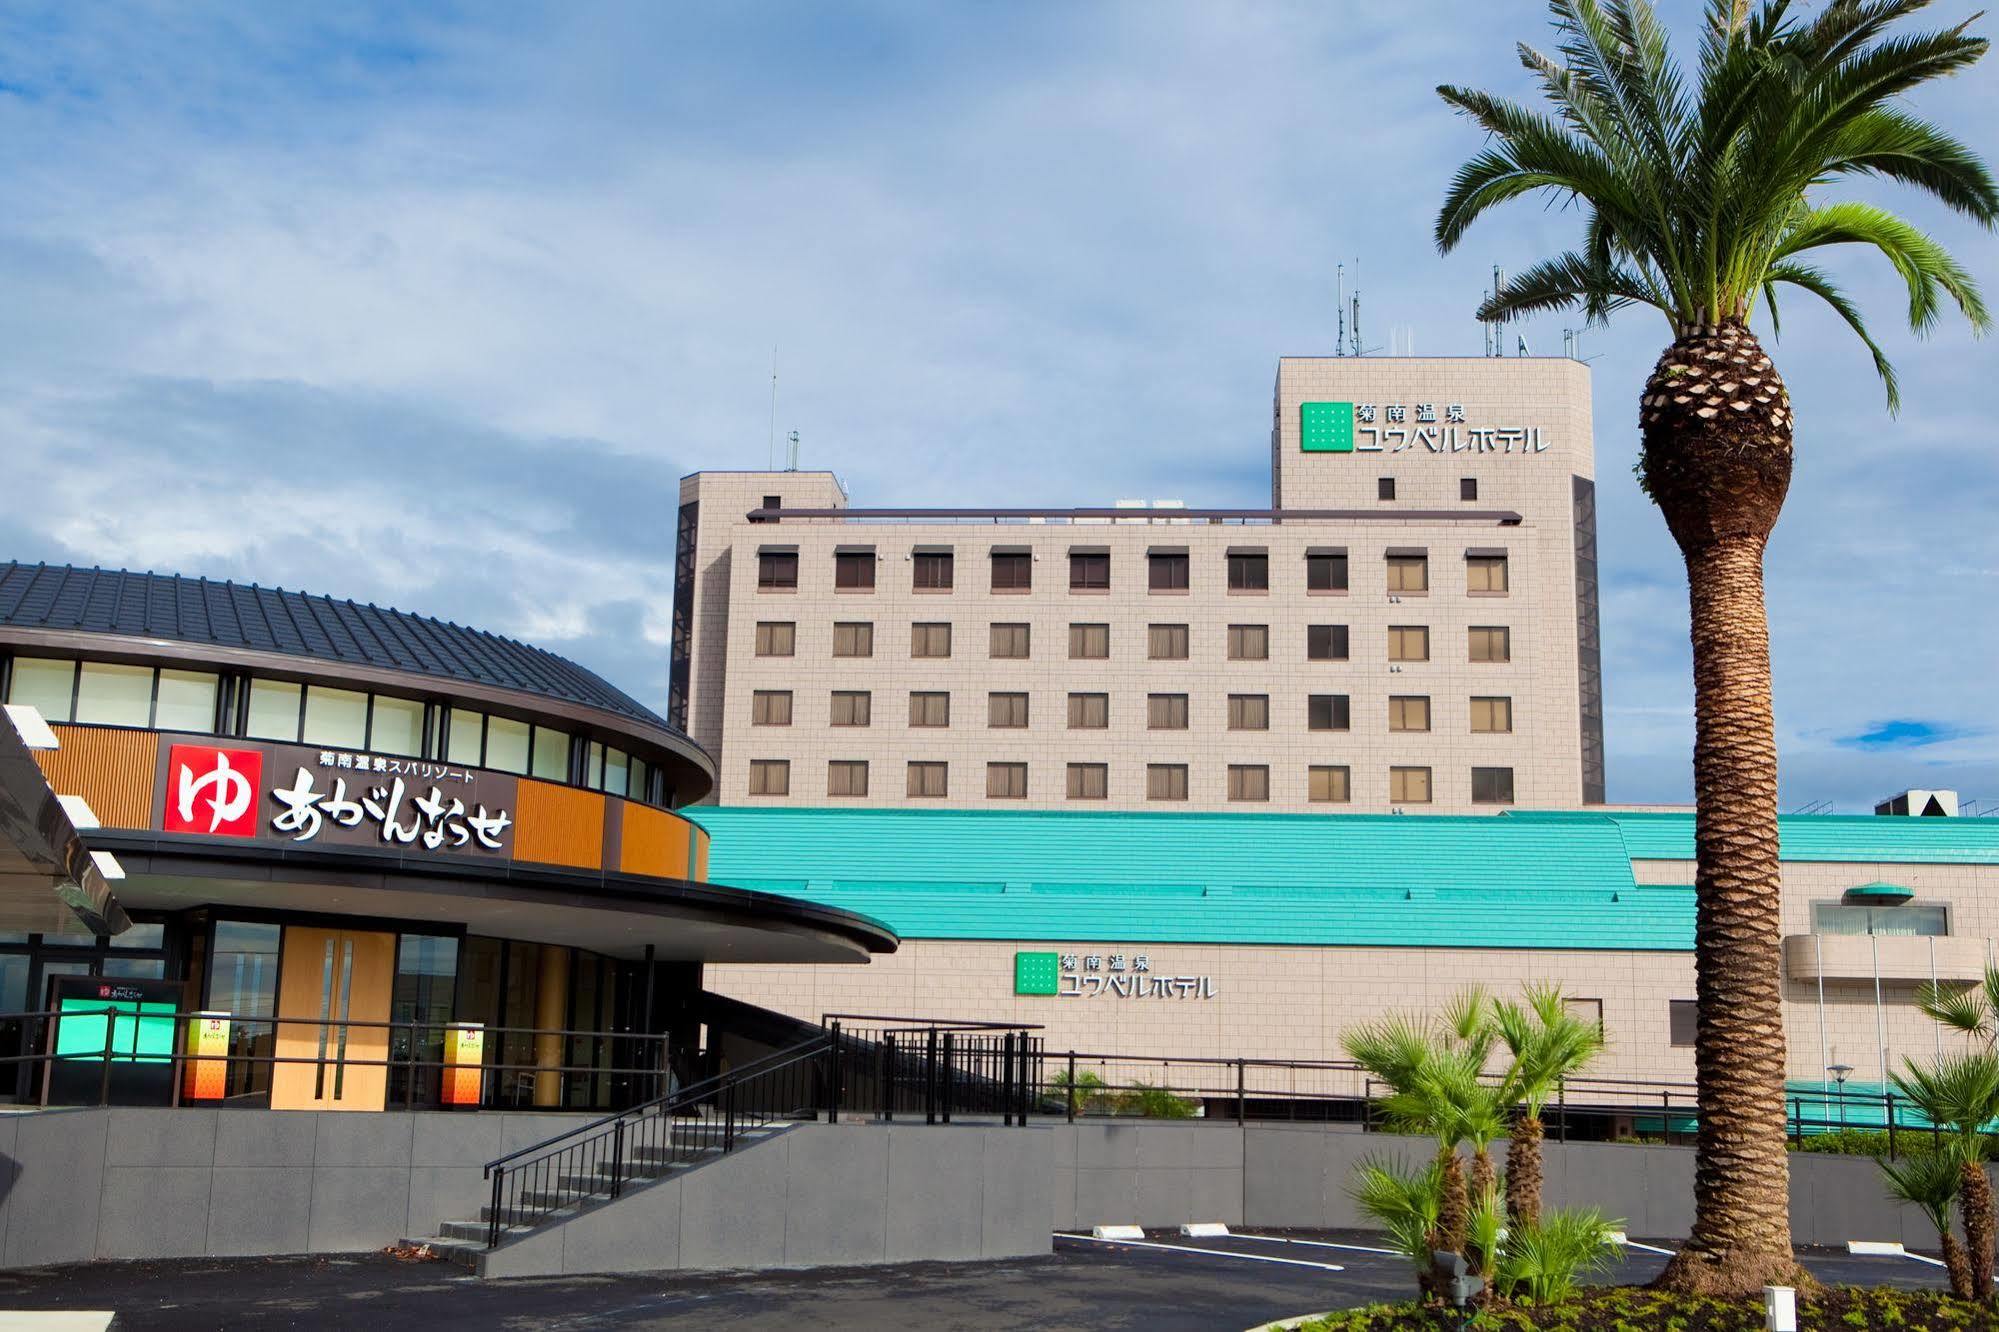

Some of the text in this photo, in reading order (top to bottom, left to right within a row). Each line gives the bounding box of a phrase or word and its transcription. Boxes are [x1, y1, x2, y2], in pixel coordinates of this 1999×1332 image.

[1357, 403, 1465, 422] 菊南温泉
[1357, 426, 1551, 453] ユウベルホテル
[177, 751, 252, 834] ゆ
[272, 766, 512, 850] あがんなっせ
[1060, 953, 1150, 971] 菊南温泉
[1060, 973, 1218, 998] ユウベルホテル
